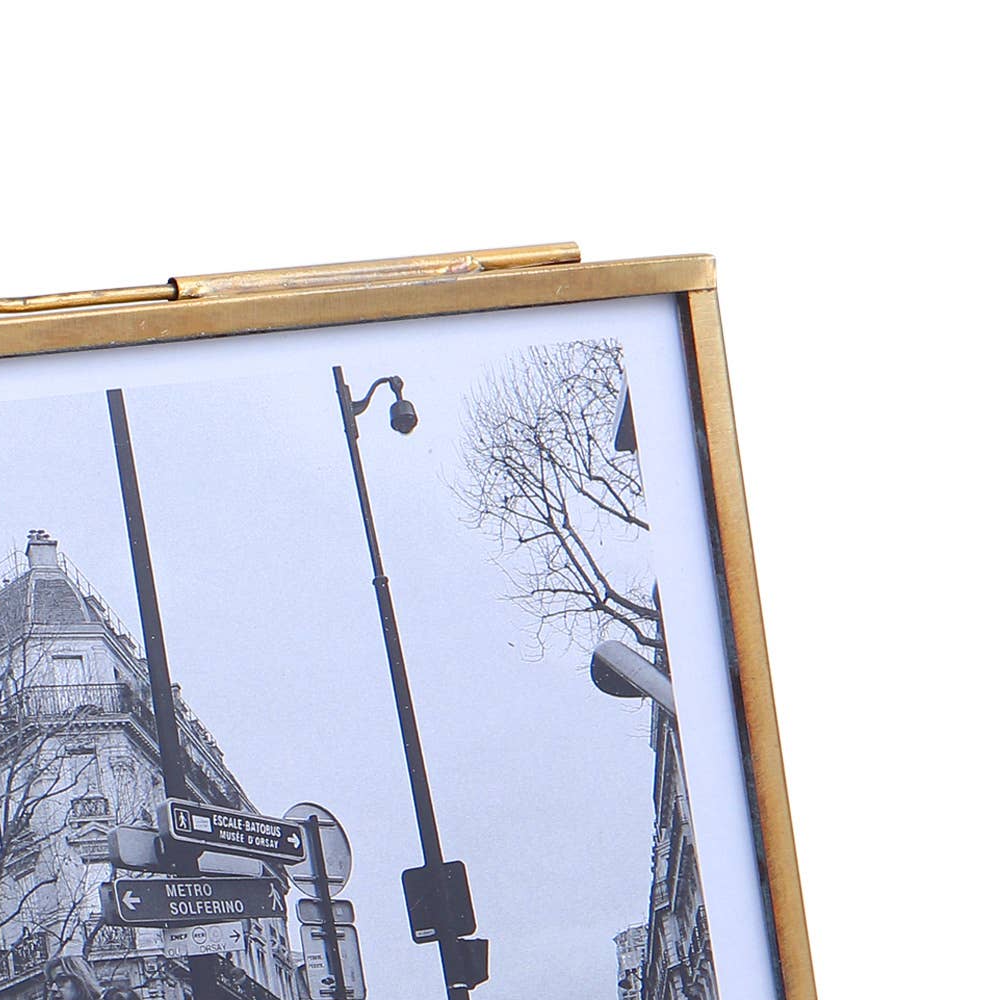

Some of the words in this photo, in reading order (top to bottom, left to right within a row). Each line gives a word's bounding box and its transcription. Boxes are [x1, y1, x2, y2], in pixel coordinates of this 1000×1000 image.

[212, 814, 282, 838] ESCALE-BATOBUS
[219, 829, 245, 843] MUSÉE
[247, 835, 279, 849] D'ORSAY
[165, 883, 212, 897] METRO
[169, 899, 244, 915] SOLFERINO
